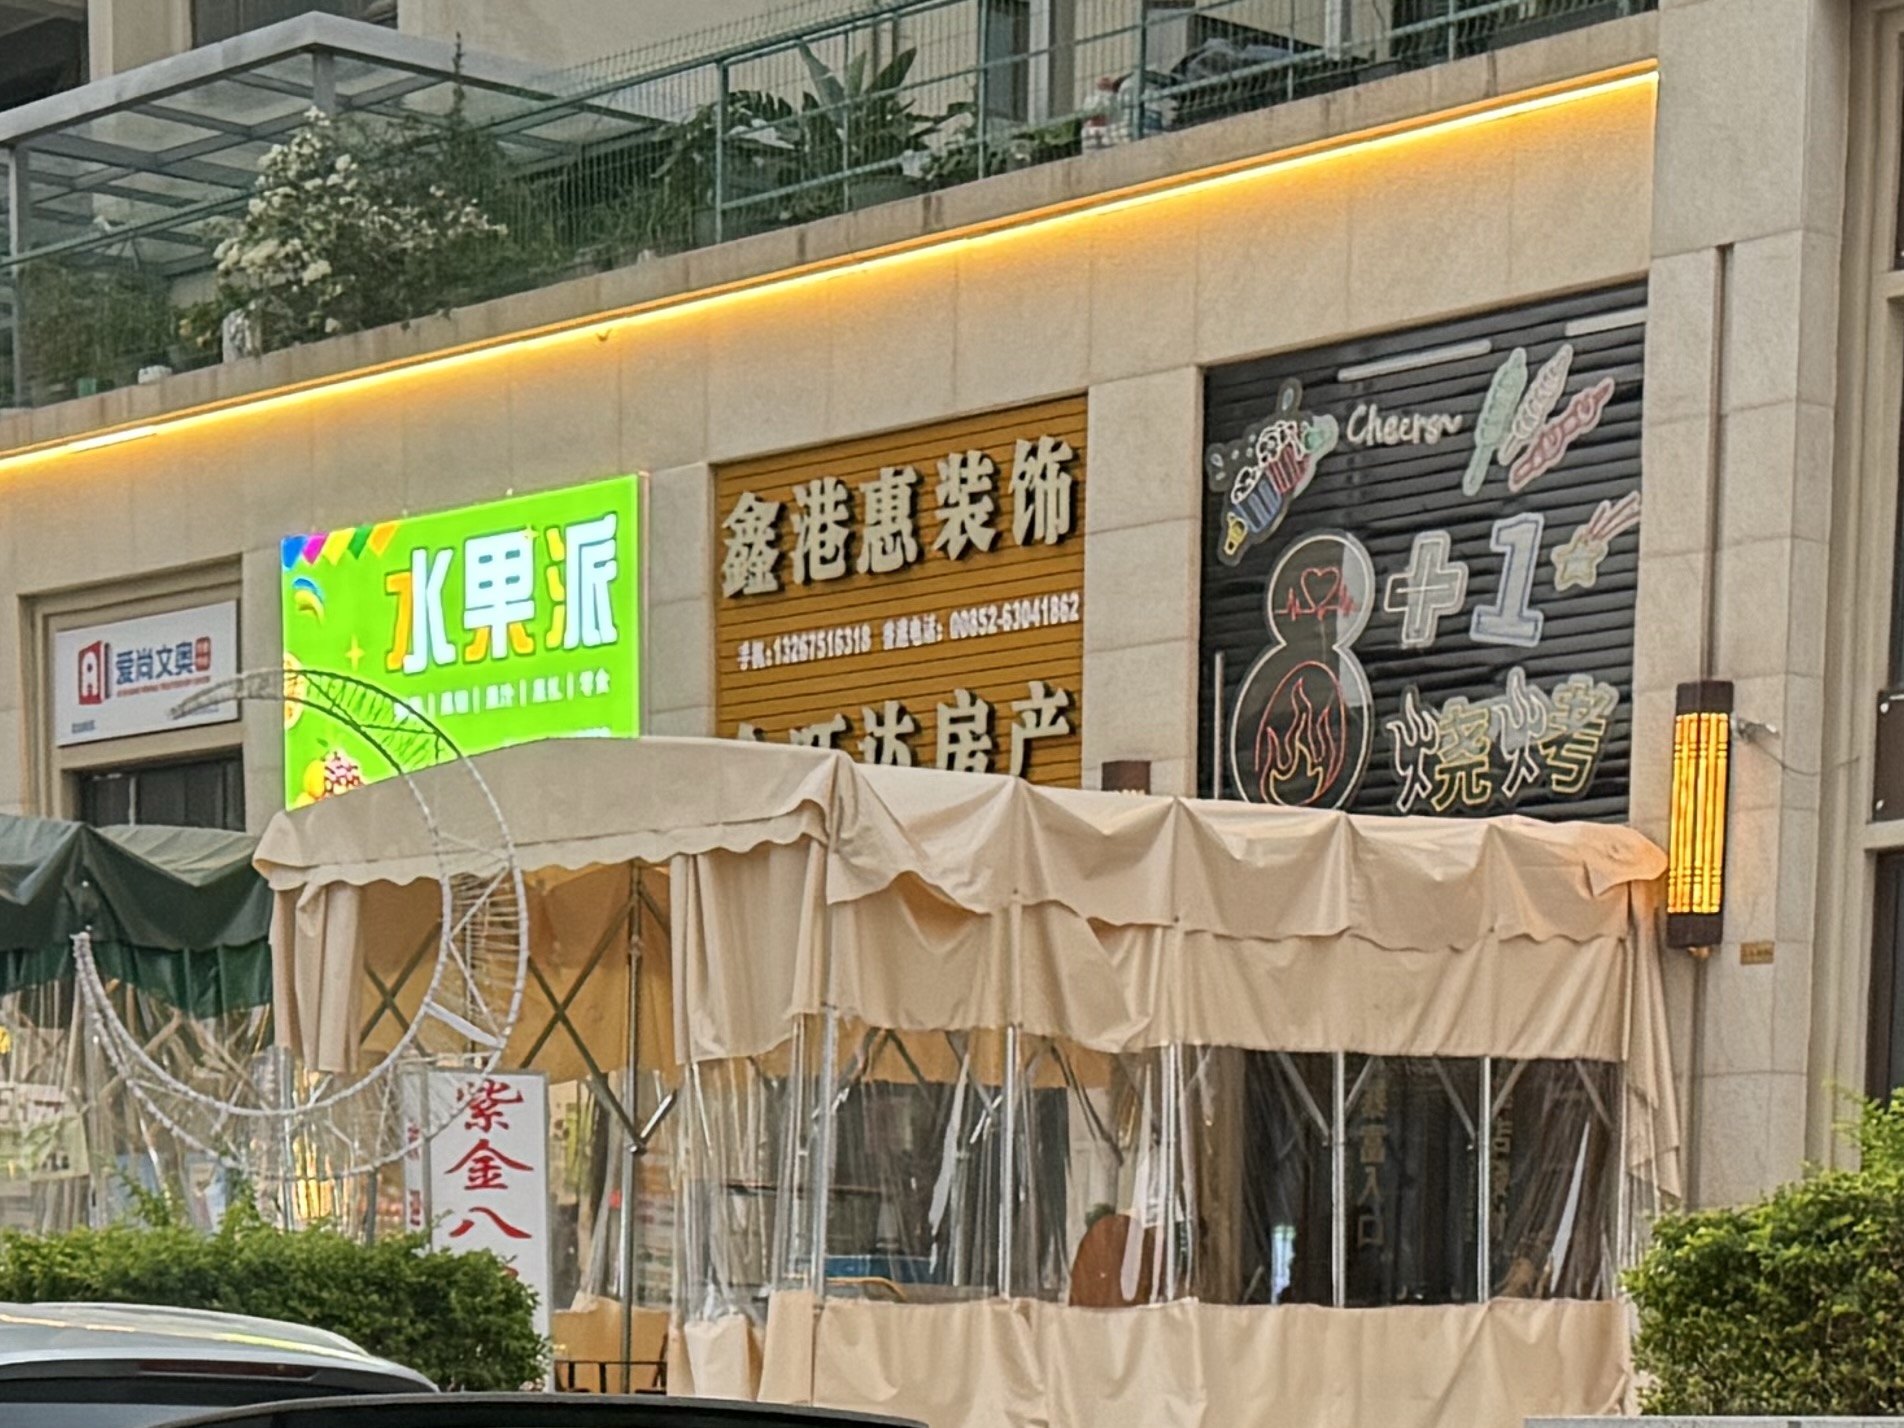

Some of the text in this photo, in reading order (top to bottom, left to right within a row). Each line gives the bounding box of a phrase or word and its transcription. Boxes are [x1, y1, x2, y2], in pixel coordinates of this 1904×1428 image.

[384, 511, 618, 675] 水果派
[722, 434, 1074, 599] 鑫港惠装饰
[734, 680, 1071, 777] 达房产
[1386, 667, 1621, 813] 烧烤
[444, 1079, 535, 1278] 紫金八
